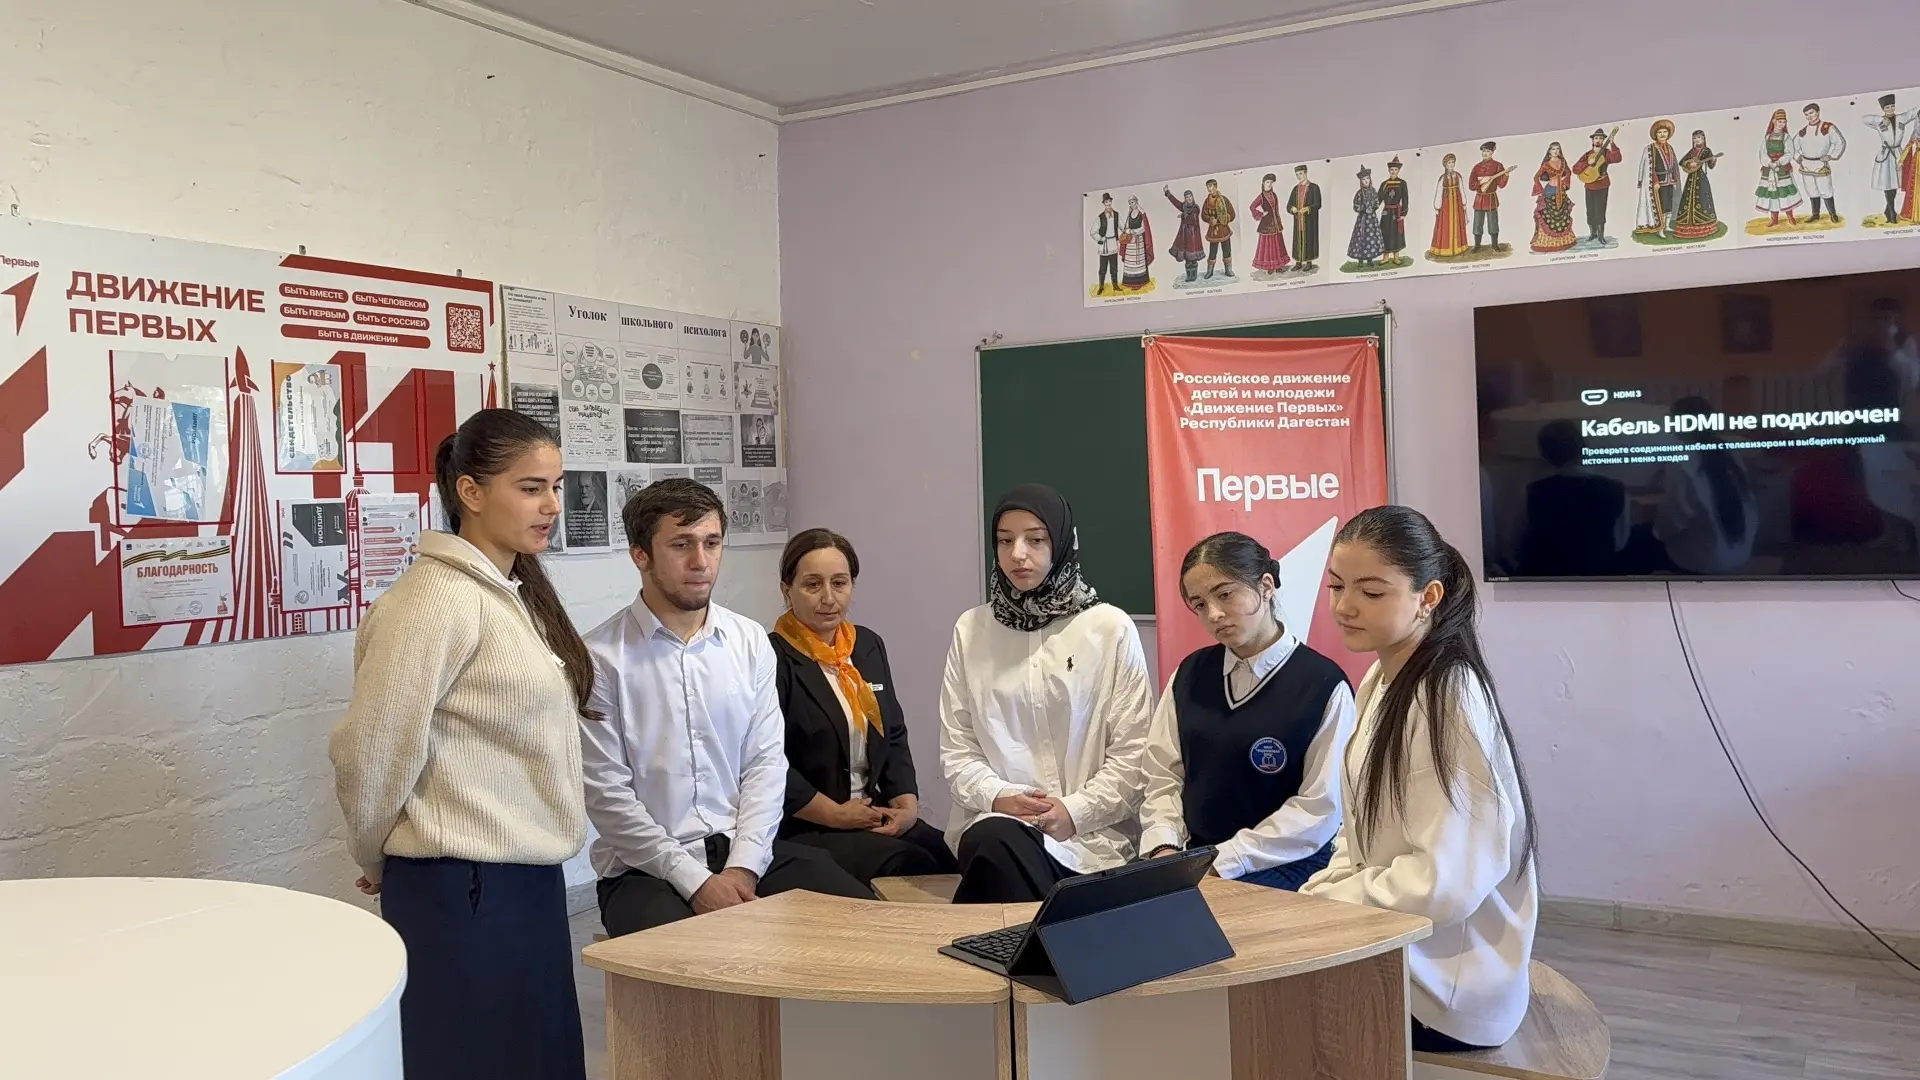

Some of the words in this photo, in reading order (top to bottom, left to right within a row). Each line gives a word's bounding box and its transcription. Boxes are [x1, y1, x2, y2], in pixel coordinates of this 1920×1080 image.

[66, 271, 266, 312] ДВИЖЕНИЕ
[284, 286, 308, 296] БЫТЬ
[310, 290, 344, 300] ВМЕСТЕ
[355, 294, 378, 304] БЫТЬ
[378, 297, 426, 309] ЧЕЛОВЕКОМ
[284, 307, 308, 316] БЫТЬ
[309, 309, 346, 319] ПЕРВЫМ
[69, 308, 217, 342] ПЕРВЫХ
[357, 314, 380, 323] БЫТЬ
[381, 316, 387, 324] С
[388, 316, 426, 328] РОССИЕЙ
[568, 305, 608, 322] Уголок
[621, 316, 673, 330] школьного
[684, 325, 727, 338] психолога
[318, 330, 342, 339] БЫТЬ
[351, 332, 398, 344] ДВИЖЕНИИ
[1173, 372, 1270, 384] Российское
[1273, 373, 1351, 385] движение
[1191, 388, 1238, 400] детей
[1242, 390, 1251, 398] и
[1254, 388, 1335, 400] молодежи
[1613, 390, 1635, 398] HDMI
[1636, 390, 1642, 398] 3
[1183, 402, 1274, 416] «Движение
[1277, 402, 1343, 415] Первых»
[286, 375, 295, 458] СВИДЕТЕЛЬСТВО
[1581, 417, 1660, 437] Кабель
[1664, 412, 1724, 433] HDMI
[1729, 415, 1757, 430] не
[1762, 408, 1899, 430] подключен
[1180, 417, 1275, 431] Республики
[1277, 417, 1350, 430] Дагестан
[1582, 447, 1629, 457] Проверьте
[1630, 445, 1683, 454] соединение
[1685, 443, 1717, 451] кабеля
[1725, 440, 1786, 449] телевизором
[1796, 436, 1843, 447] выберите
[1845, 434, 1885, 445] нужный
[1582, 457, 1622, 465] источник
[1657, 455, 1689, 463] входов
[1197, 468, 1339, 511] Первые
[315, 506, 324, 544] ДИПЛОМ
[137, 563, 218, 578] БЛАГОДАРНОСТЬ
